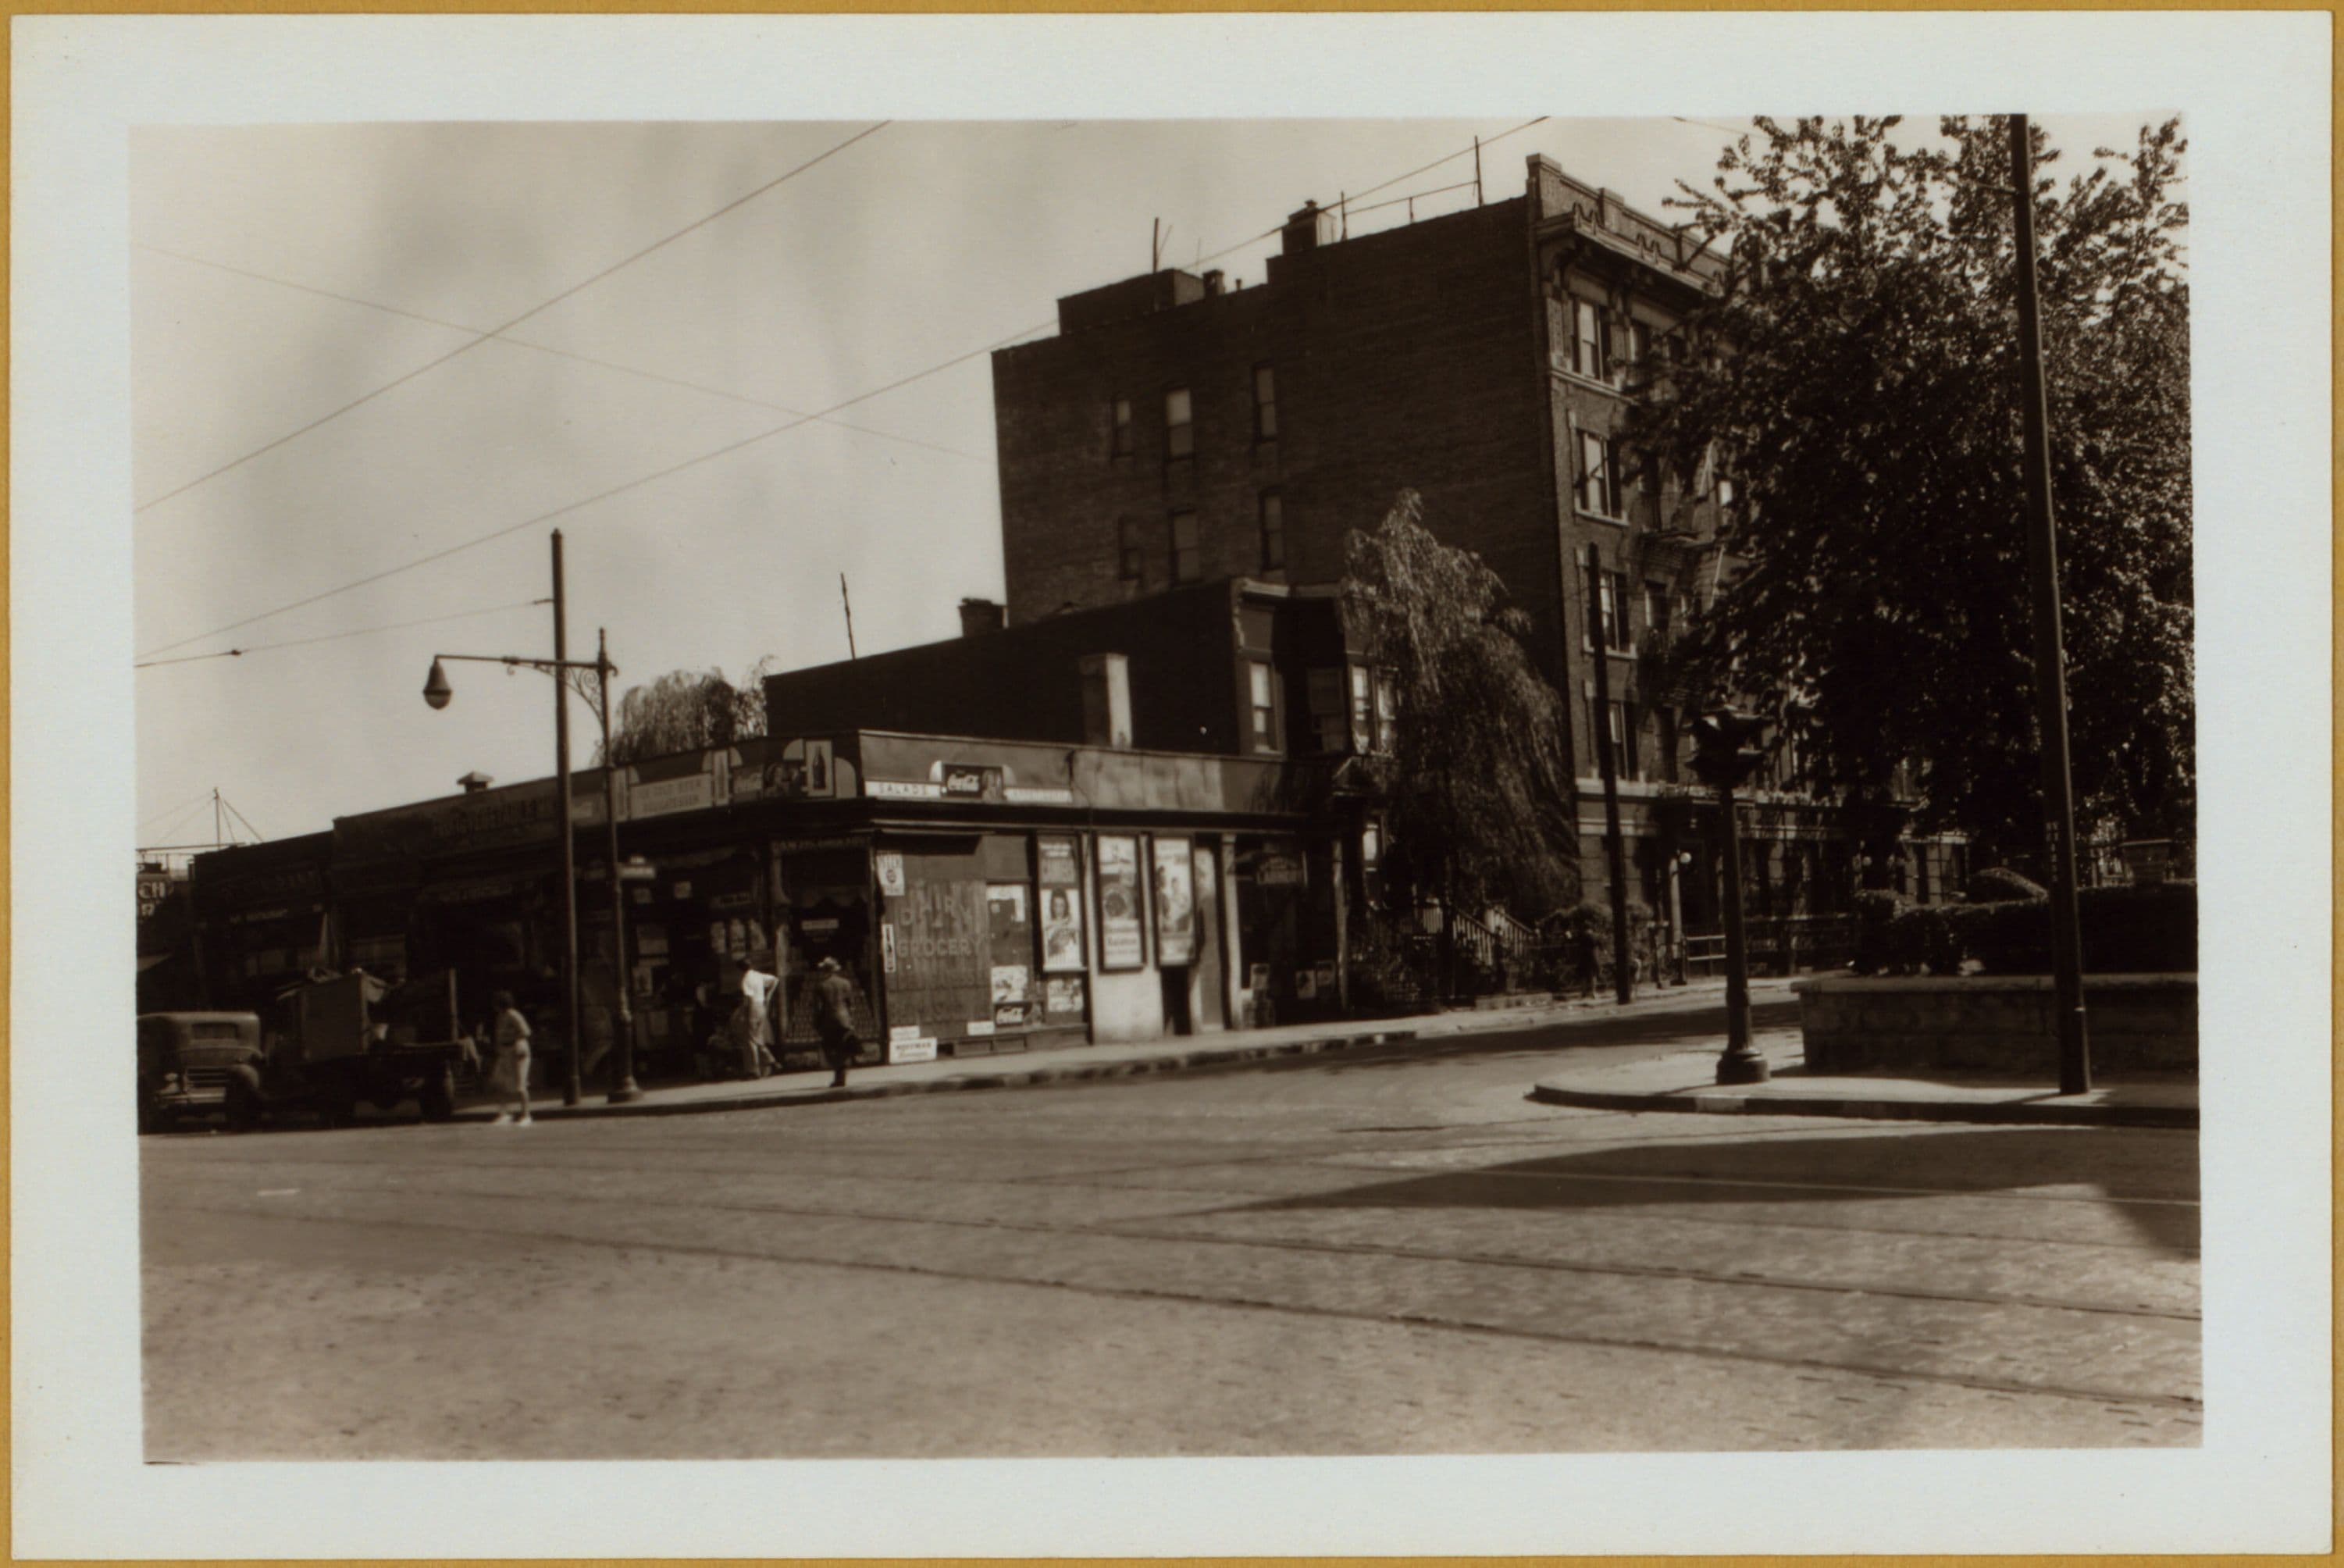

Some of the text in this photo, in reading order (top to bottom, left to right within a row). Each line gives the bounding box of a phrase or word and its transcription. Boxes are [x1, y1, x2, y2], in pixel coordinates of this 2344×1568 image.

[879, 782, 928, 796] SALADS
[900, 895, 974, 925] DAIRY
[898, 937, 984, 957] GROCERY
